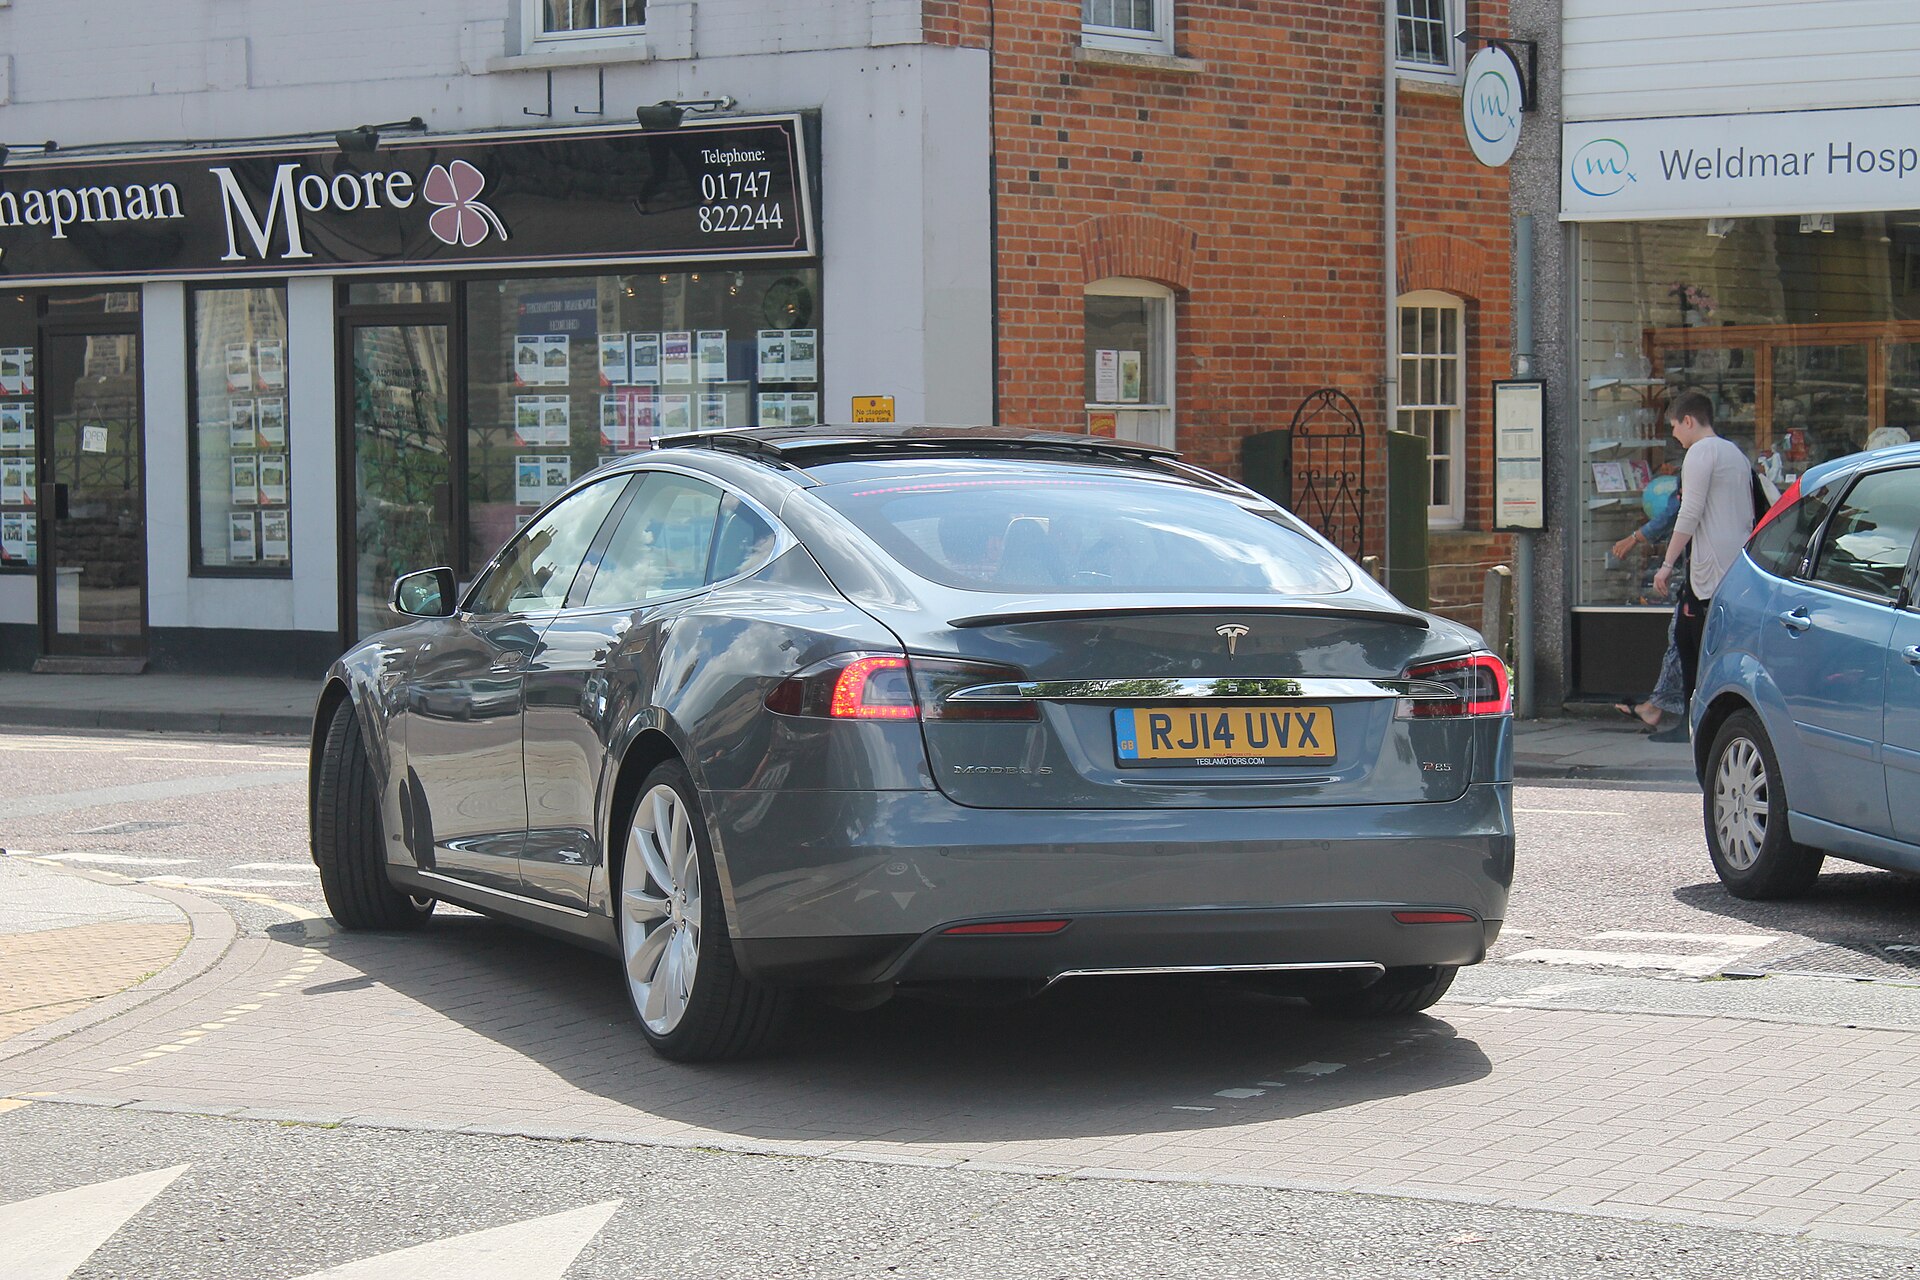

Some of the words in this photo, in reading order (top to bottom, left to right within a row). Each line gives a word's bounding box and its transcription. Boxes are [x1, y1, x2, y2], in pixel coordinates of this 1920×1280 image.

[701, 149, 766, 166] Telephone:
[1660, 147, 1815, 181] Weldmar
[701, 170, 772, 201] 01747
[0, 182, 185, 240] hapman
[209, 163, 416, 262] Moore
[698, 203, 784, 233] 822244
[85, 431, 106, 441] OPEN
[1149, 713, 1235, 749] RJ14
[1244, 712, 1320, 749] UVX
[1121, 740, 1134, 750] GB
[953, 764, 1033, 774] MODEL
[1195, 757, 1265, 765] TESLAMOTORS.COM
